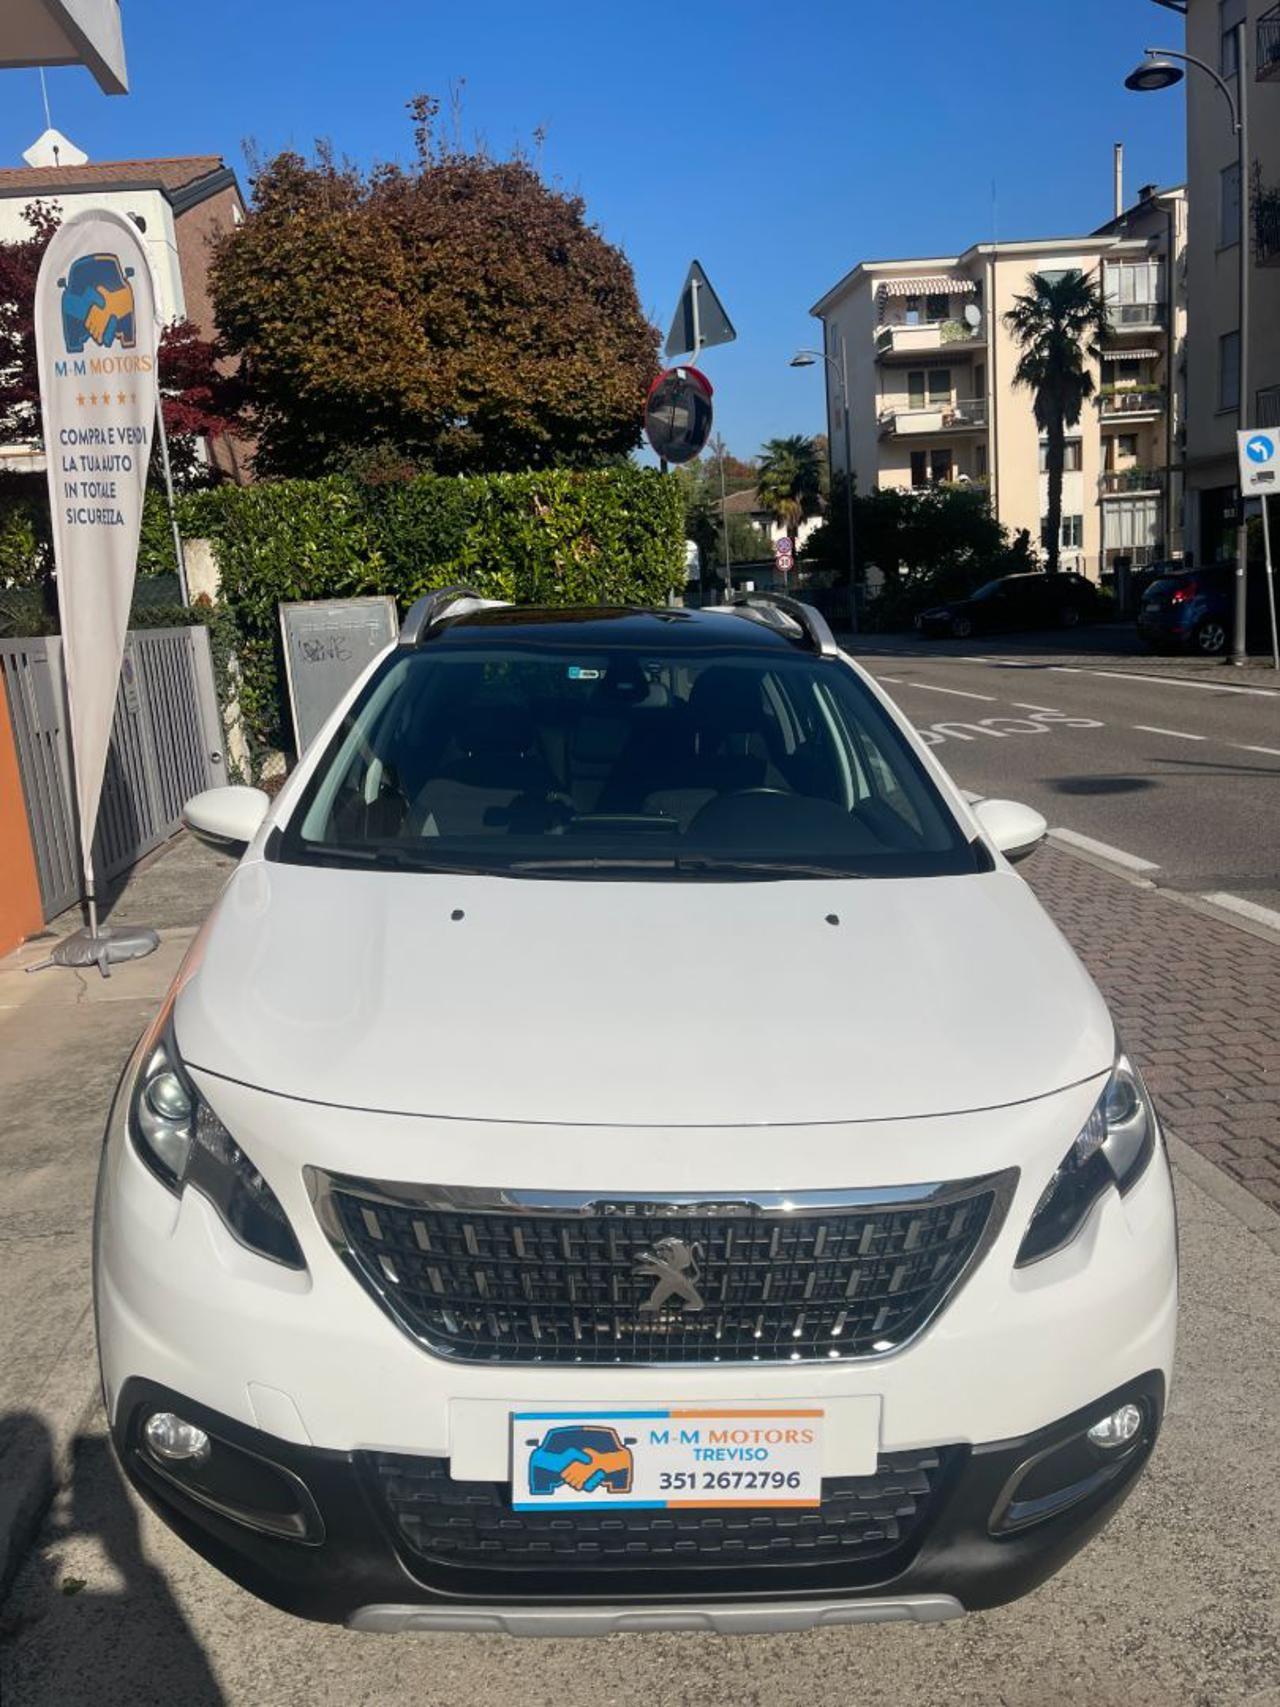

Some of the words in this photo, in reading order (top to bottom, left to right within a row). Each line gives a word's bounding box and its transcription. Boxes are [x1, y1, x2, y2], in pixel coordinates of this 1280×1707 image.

[55, 360, 87, 377] M-M
[89, 356, 152, 375] MOTORS
[60, 428, 106, 445] COMPRA
[108, 428, 115, 445] E
[62, 456, 78, 472] LA
[80, 455, 101, 472] TUA
[102, 455, 132, 472] AUTO
[64, 482, 78, 499] IN
[80, 482, 117, 499] TOTALE
[65, 508, 125, 526] SICUREZZA
[650, 1430, 700, 1445] M-M
[708, 1429, 814, 1444] MOTORS
[693, 1447, 769, 1462] TREVISO
[659, 1472, 696, 1490] 351
[702, 1471, 801, 1490] 2672796
